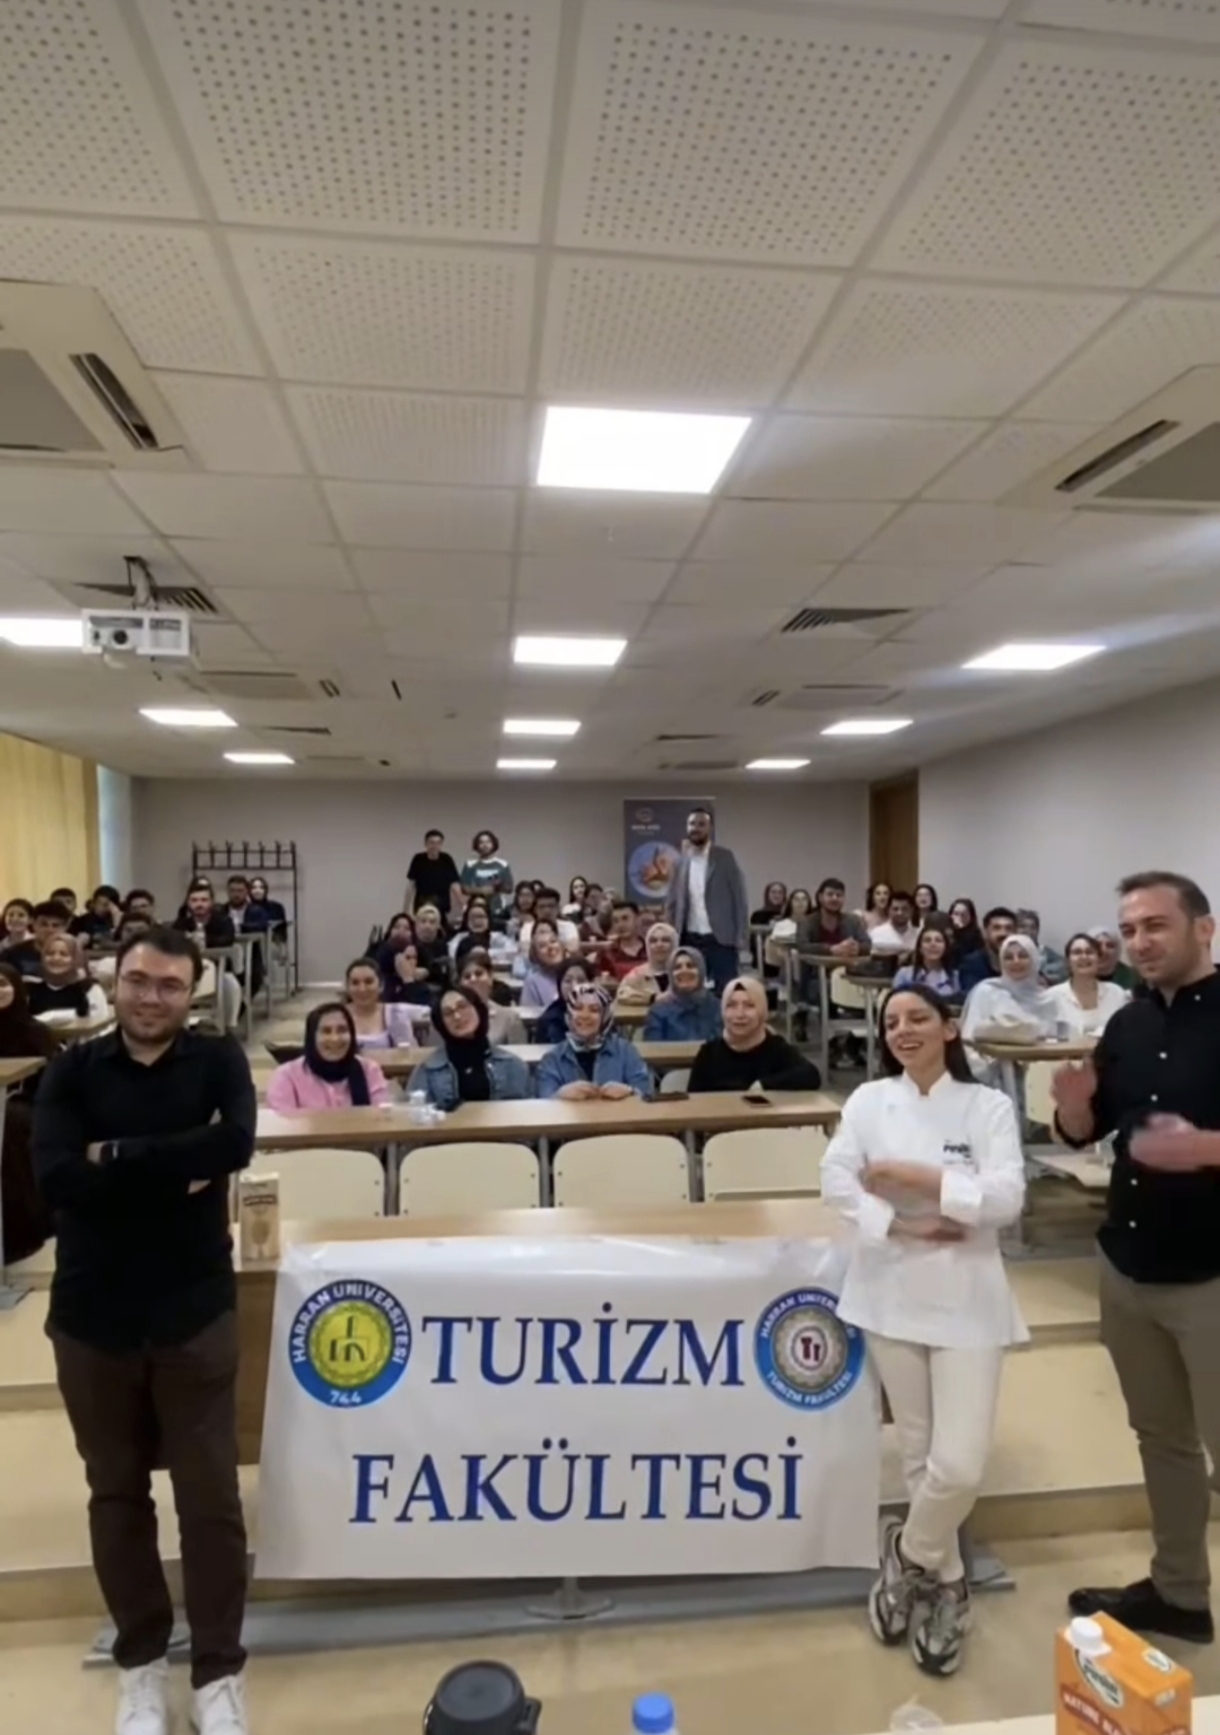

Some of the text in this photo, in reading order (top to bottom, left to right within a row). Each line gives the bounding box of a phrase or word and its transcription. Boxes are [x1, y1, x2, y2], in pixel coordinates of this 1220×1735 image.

[291, 1290, 331, 1364] HARRAN
[422, 1302, 745, 1387] TURİZM
[349, 1436, 803, 1523] FAKÜLTESİ
